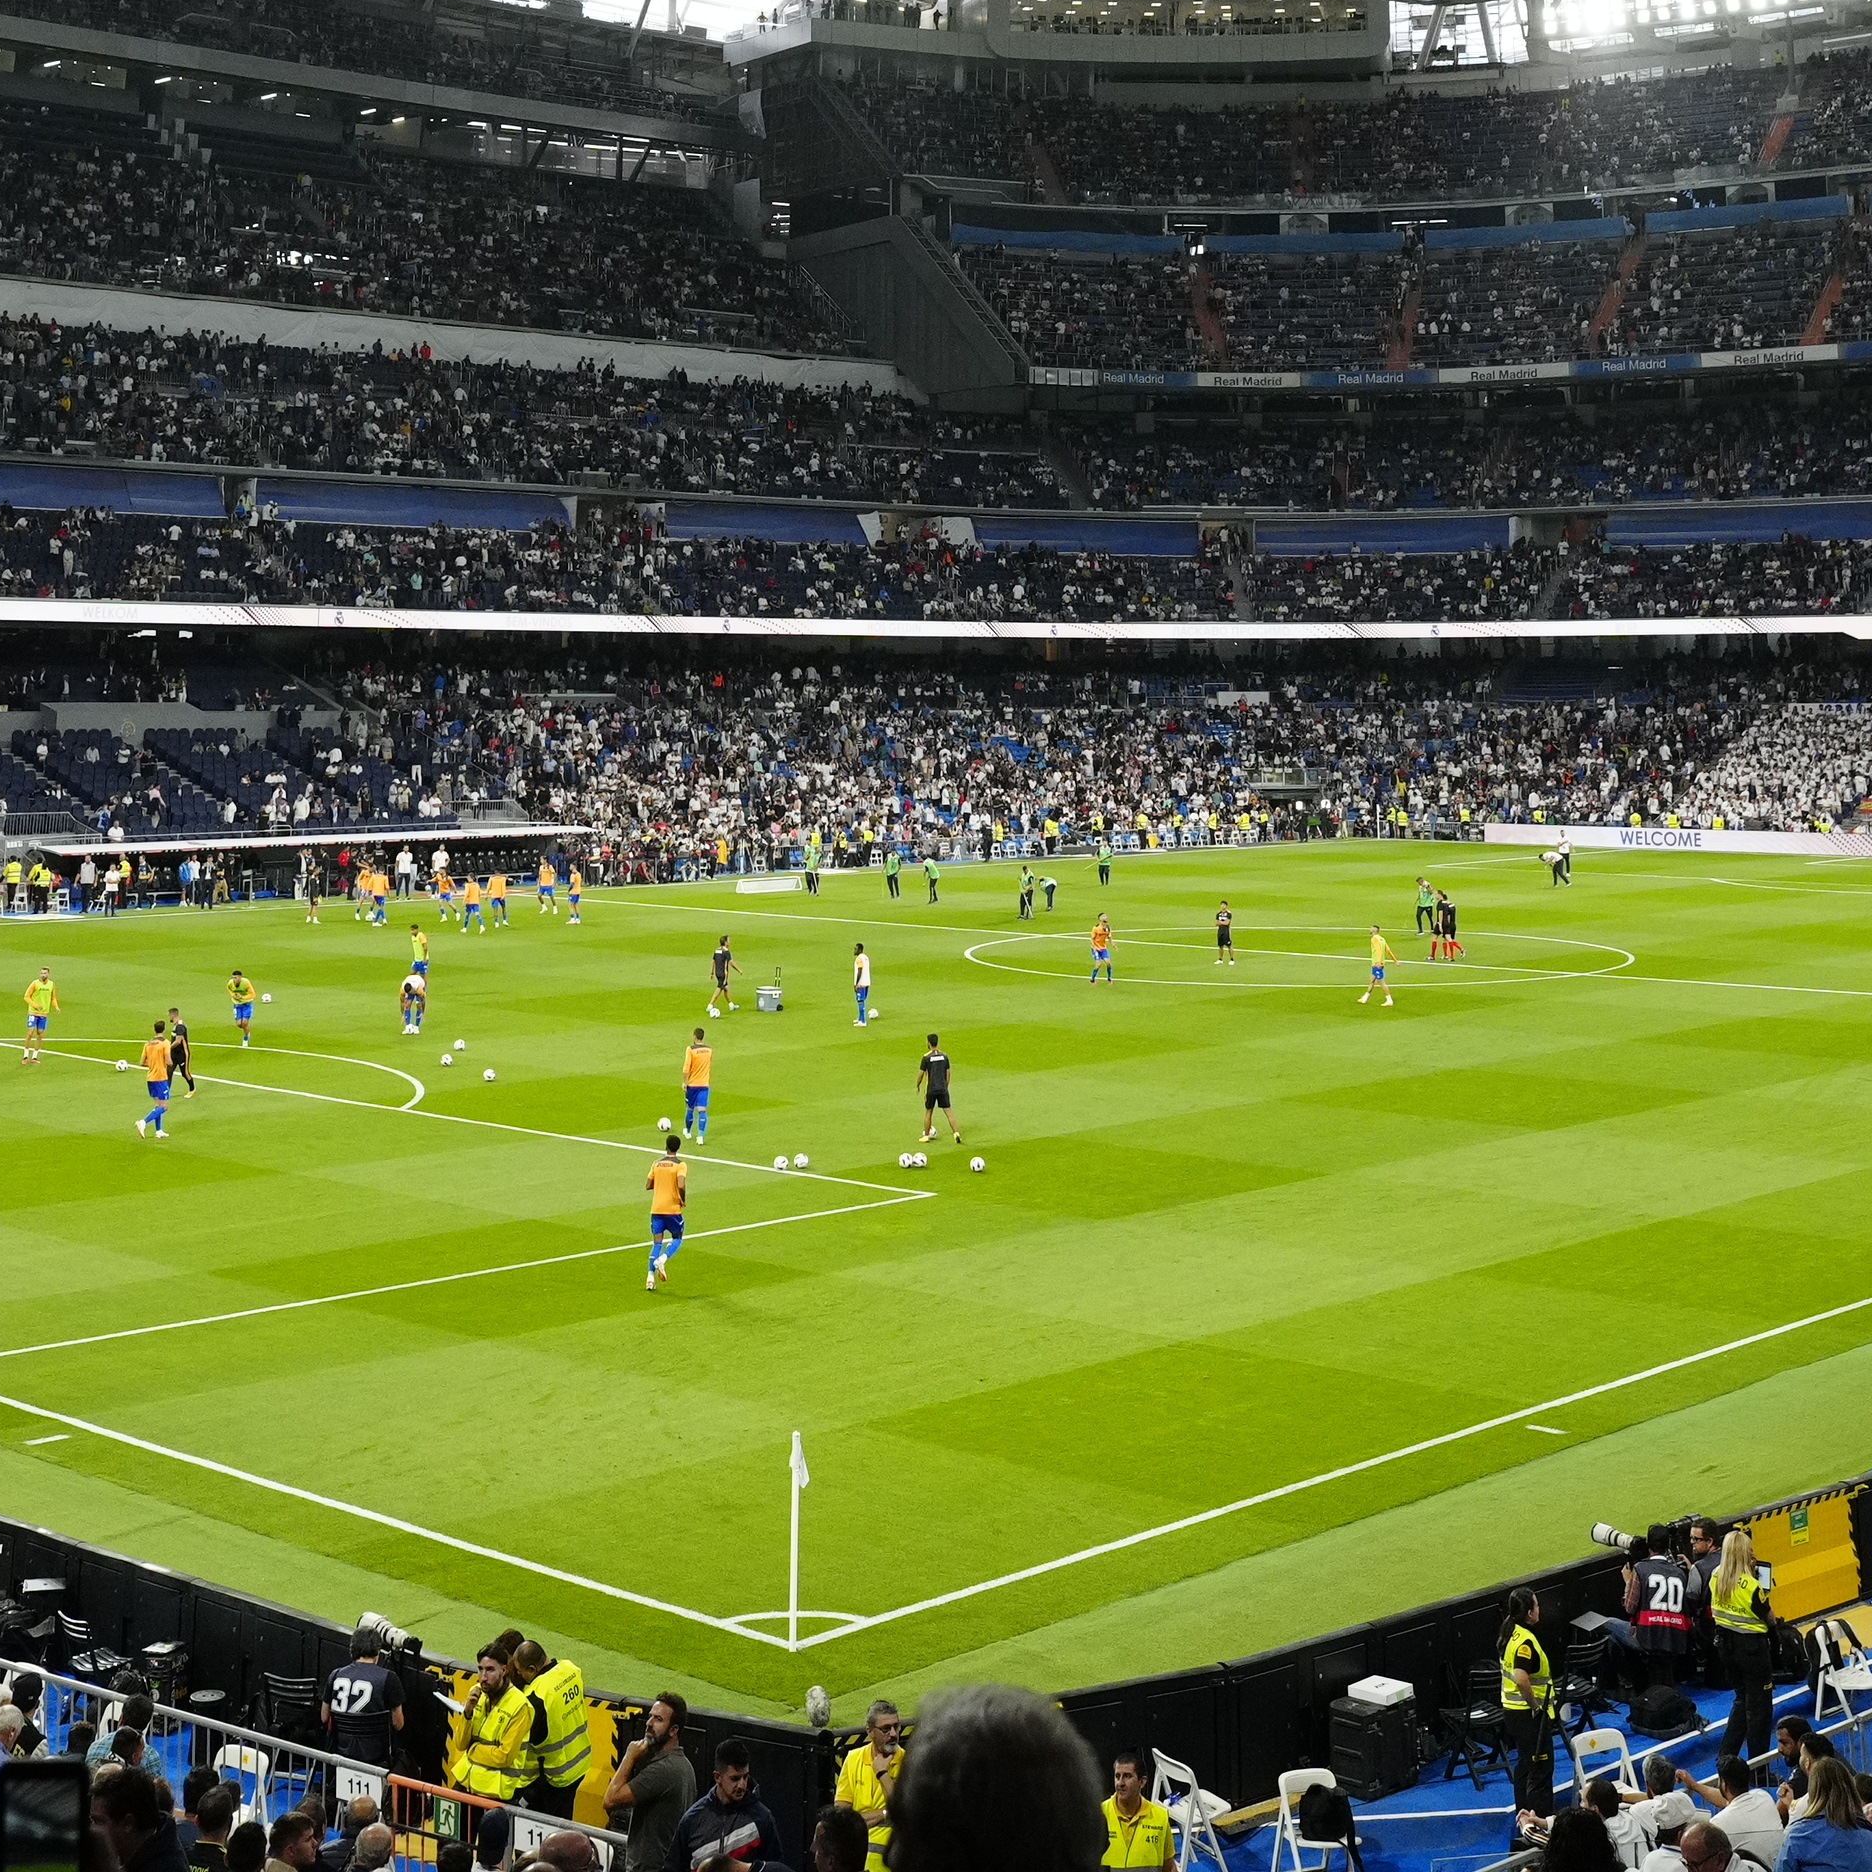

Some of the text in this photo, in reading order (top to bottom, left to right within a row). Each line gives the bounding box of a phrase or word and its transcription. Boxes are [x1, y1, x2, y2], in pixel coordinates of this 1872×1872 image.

[1602, 358, 1667, 371] Real Madrid
[1734, 351, 1805, 365] Real Madrid
[1103, 373, 1165, 384] Real Madrid
[1338, 373, 1404, 385] Real Madrid
[1471, 368, 1538, 381] Real Madrid
[1214, 376, 1283, 387] Real Madrid
[82, 606, 138, 619] WELKOM
[1620, 831, 1702, 847] WELCOME
[1648, 1574, 1684, 1613] 20
[330, 1677, 374, 1714] 32
[562, 1685, 580, 1705] 260
[348, 1778, 371, 1795] 111
[1145, 1835, 1159, 1844] 416
